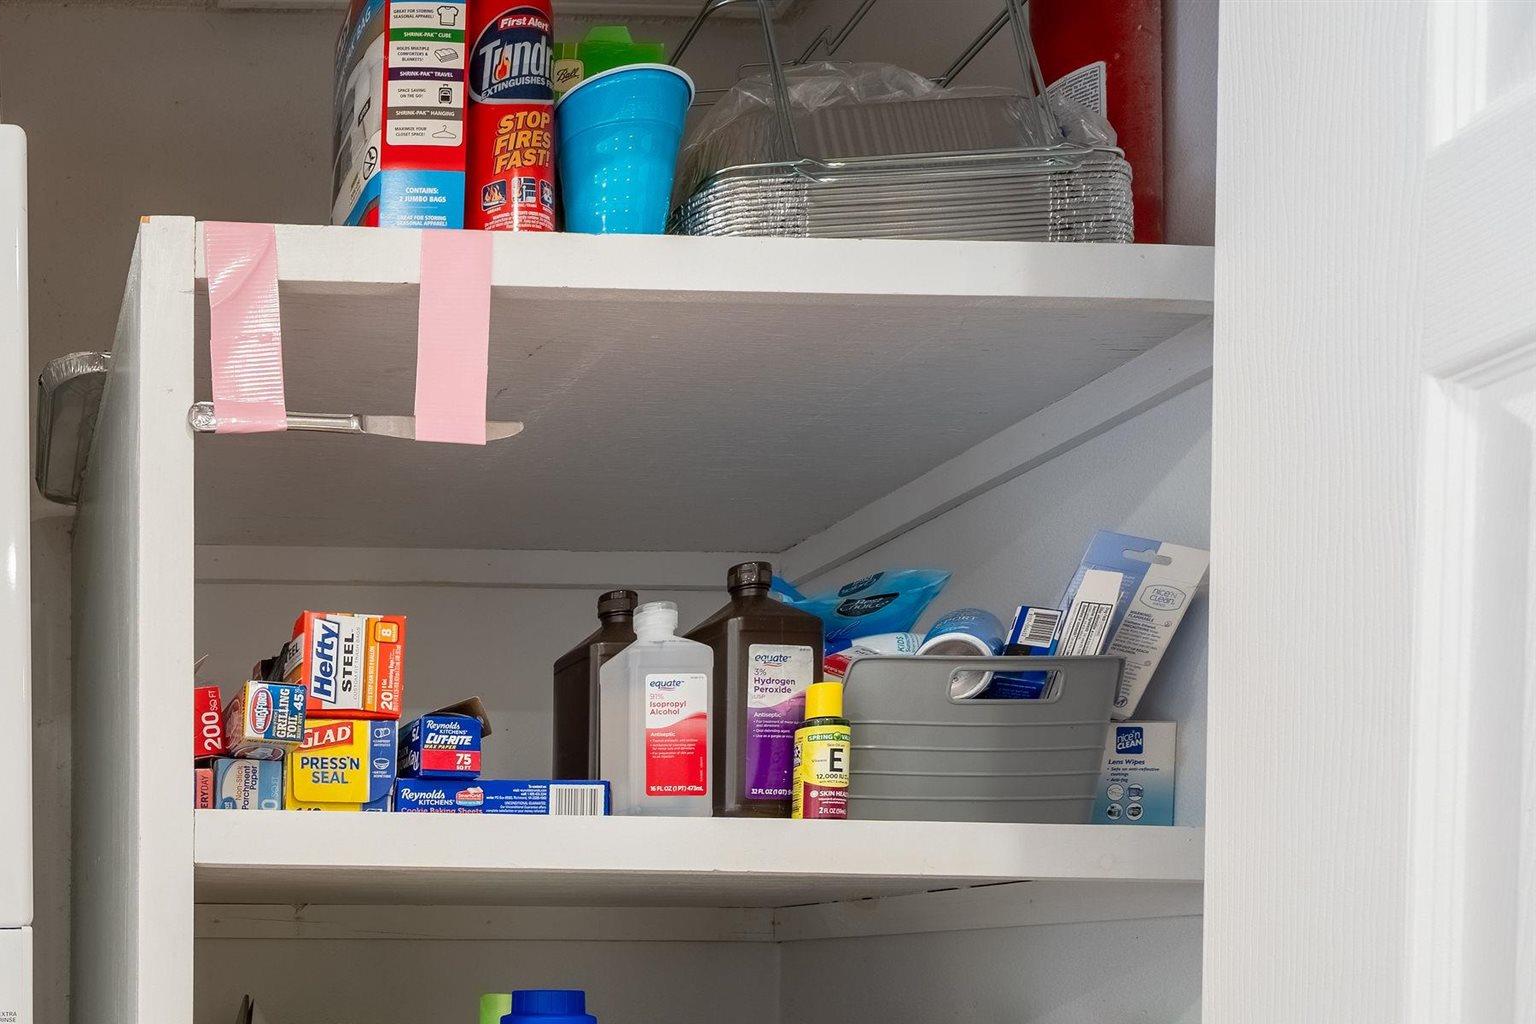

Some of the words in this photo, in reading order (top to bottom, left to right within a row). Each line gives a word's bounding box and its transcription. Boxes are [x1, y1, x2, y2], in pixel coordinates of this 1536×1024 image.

[500, 17, 526, 28] First
[528, 18, 548, 31] Alert
[482, 76, 545, 100] EXTINGUISHES
[498, 111, 550, 134] STOP
[495, 131, 550, 156] FIRES
[495, 149, 549, 174] FAST!
[314, 624, 339, 698] Hefty
[342, 634, 354, 692] STEEL
[754, 654, 788, 664] equate
[649, 680, 681, 690] equate
[754, 678, 796, 686] Hydrogen
[254, 691, 269, 730] KINGSFORD
[294, 694, 304, 711] 45
[381, 692, 393, 710] 20
[650, 700, 686, 708] Isopropyl
[276, 688, 290, 738] GRILLING
[201, 712, 222, 750] 200
[286, 714, 298, 738] FOIL
[426, 720, 460, 731] Reynolds
[300, 726, 350, 748] GLAD
[1117, 730, 1140, 743] nice'n
[1117, 739, 1142, 750] CLEAN
[456, 754, 472, 766] 75
[830, 748, 844, 772] E
[250, 766, 258, 790] Paper
[312, 771, 348, 784] SEAL
[400, 788, 445, 802] Reynolds
